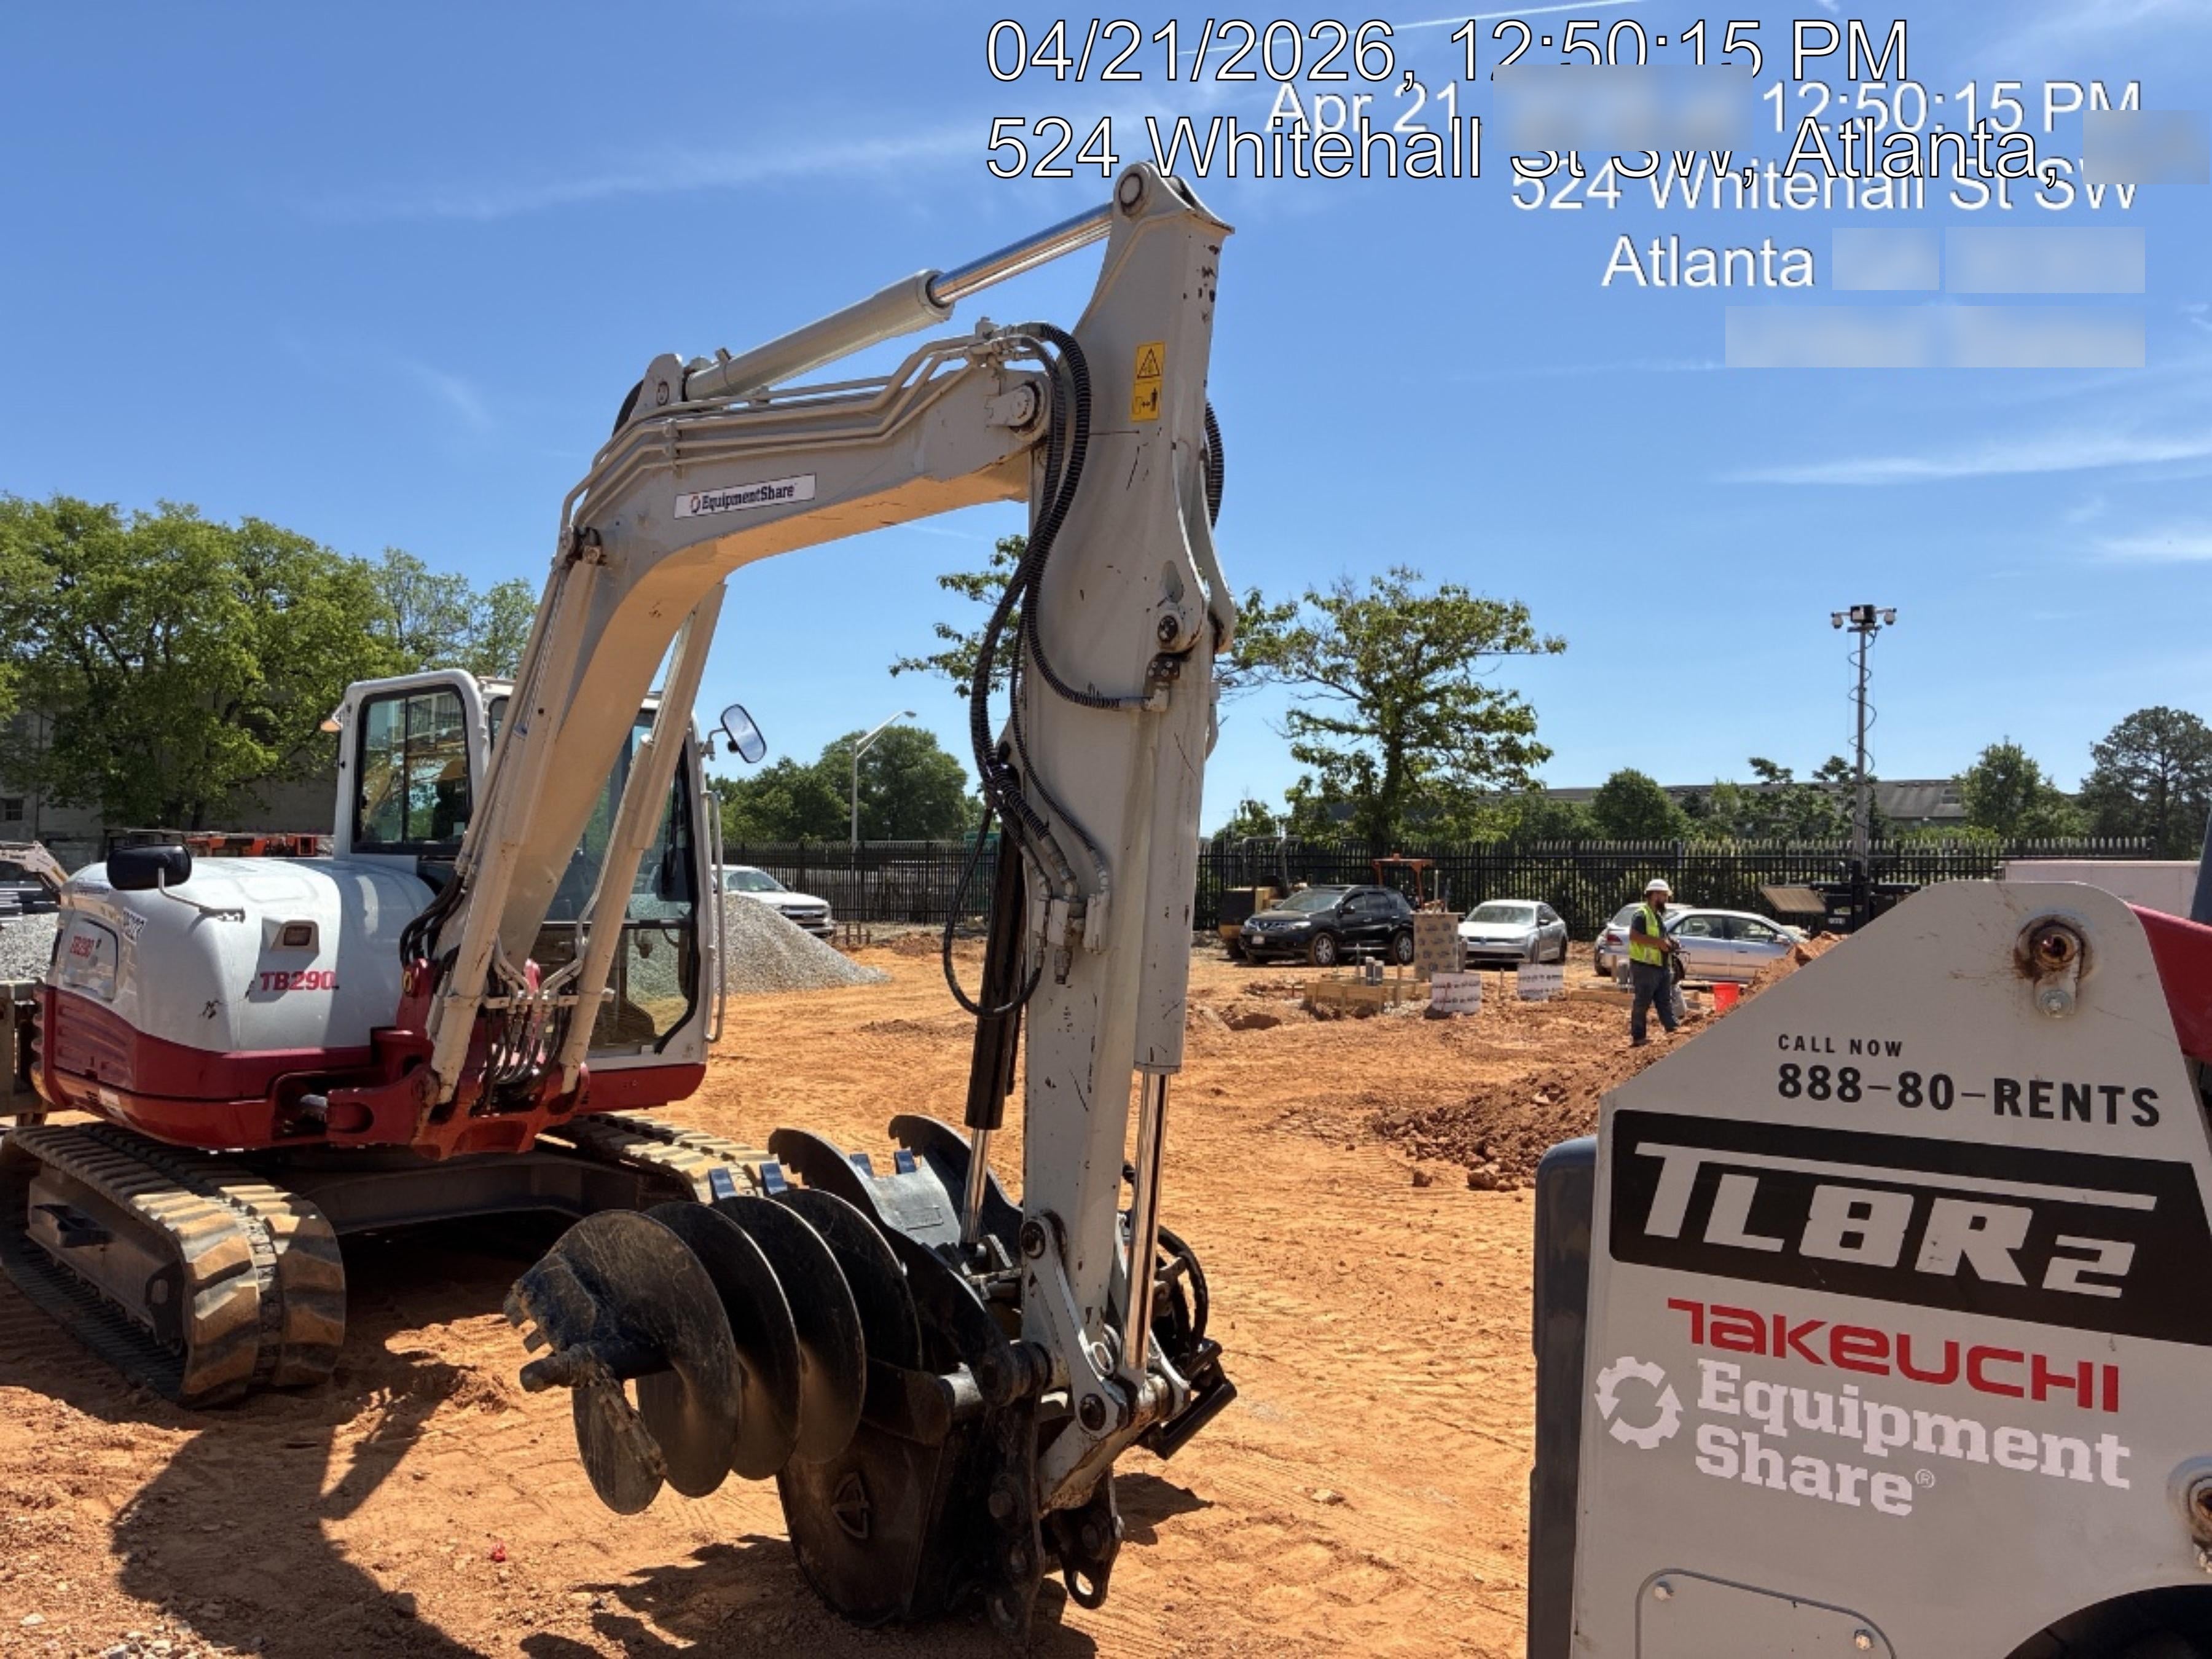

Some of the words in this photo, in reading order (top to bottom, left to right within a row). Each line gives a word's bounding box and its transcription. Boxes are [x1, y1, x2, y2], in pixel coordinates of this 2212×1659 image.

[702, 485, 795, 511] EquipmentShare
[260, 970, 336, 991] TB290
[1778, 1034, 1837, 1054] CALL
[1849, 1038, 1902, 1057] NOW
[1778, 1062, 2160, 1128] 888-80-RENTS
[1696, 1358, 2131, 1490] Equipment
